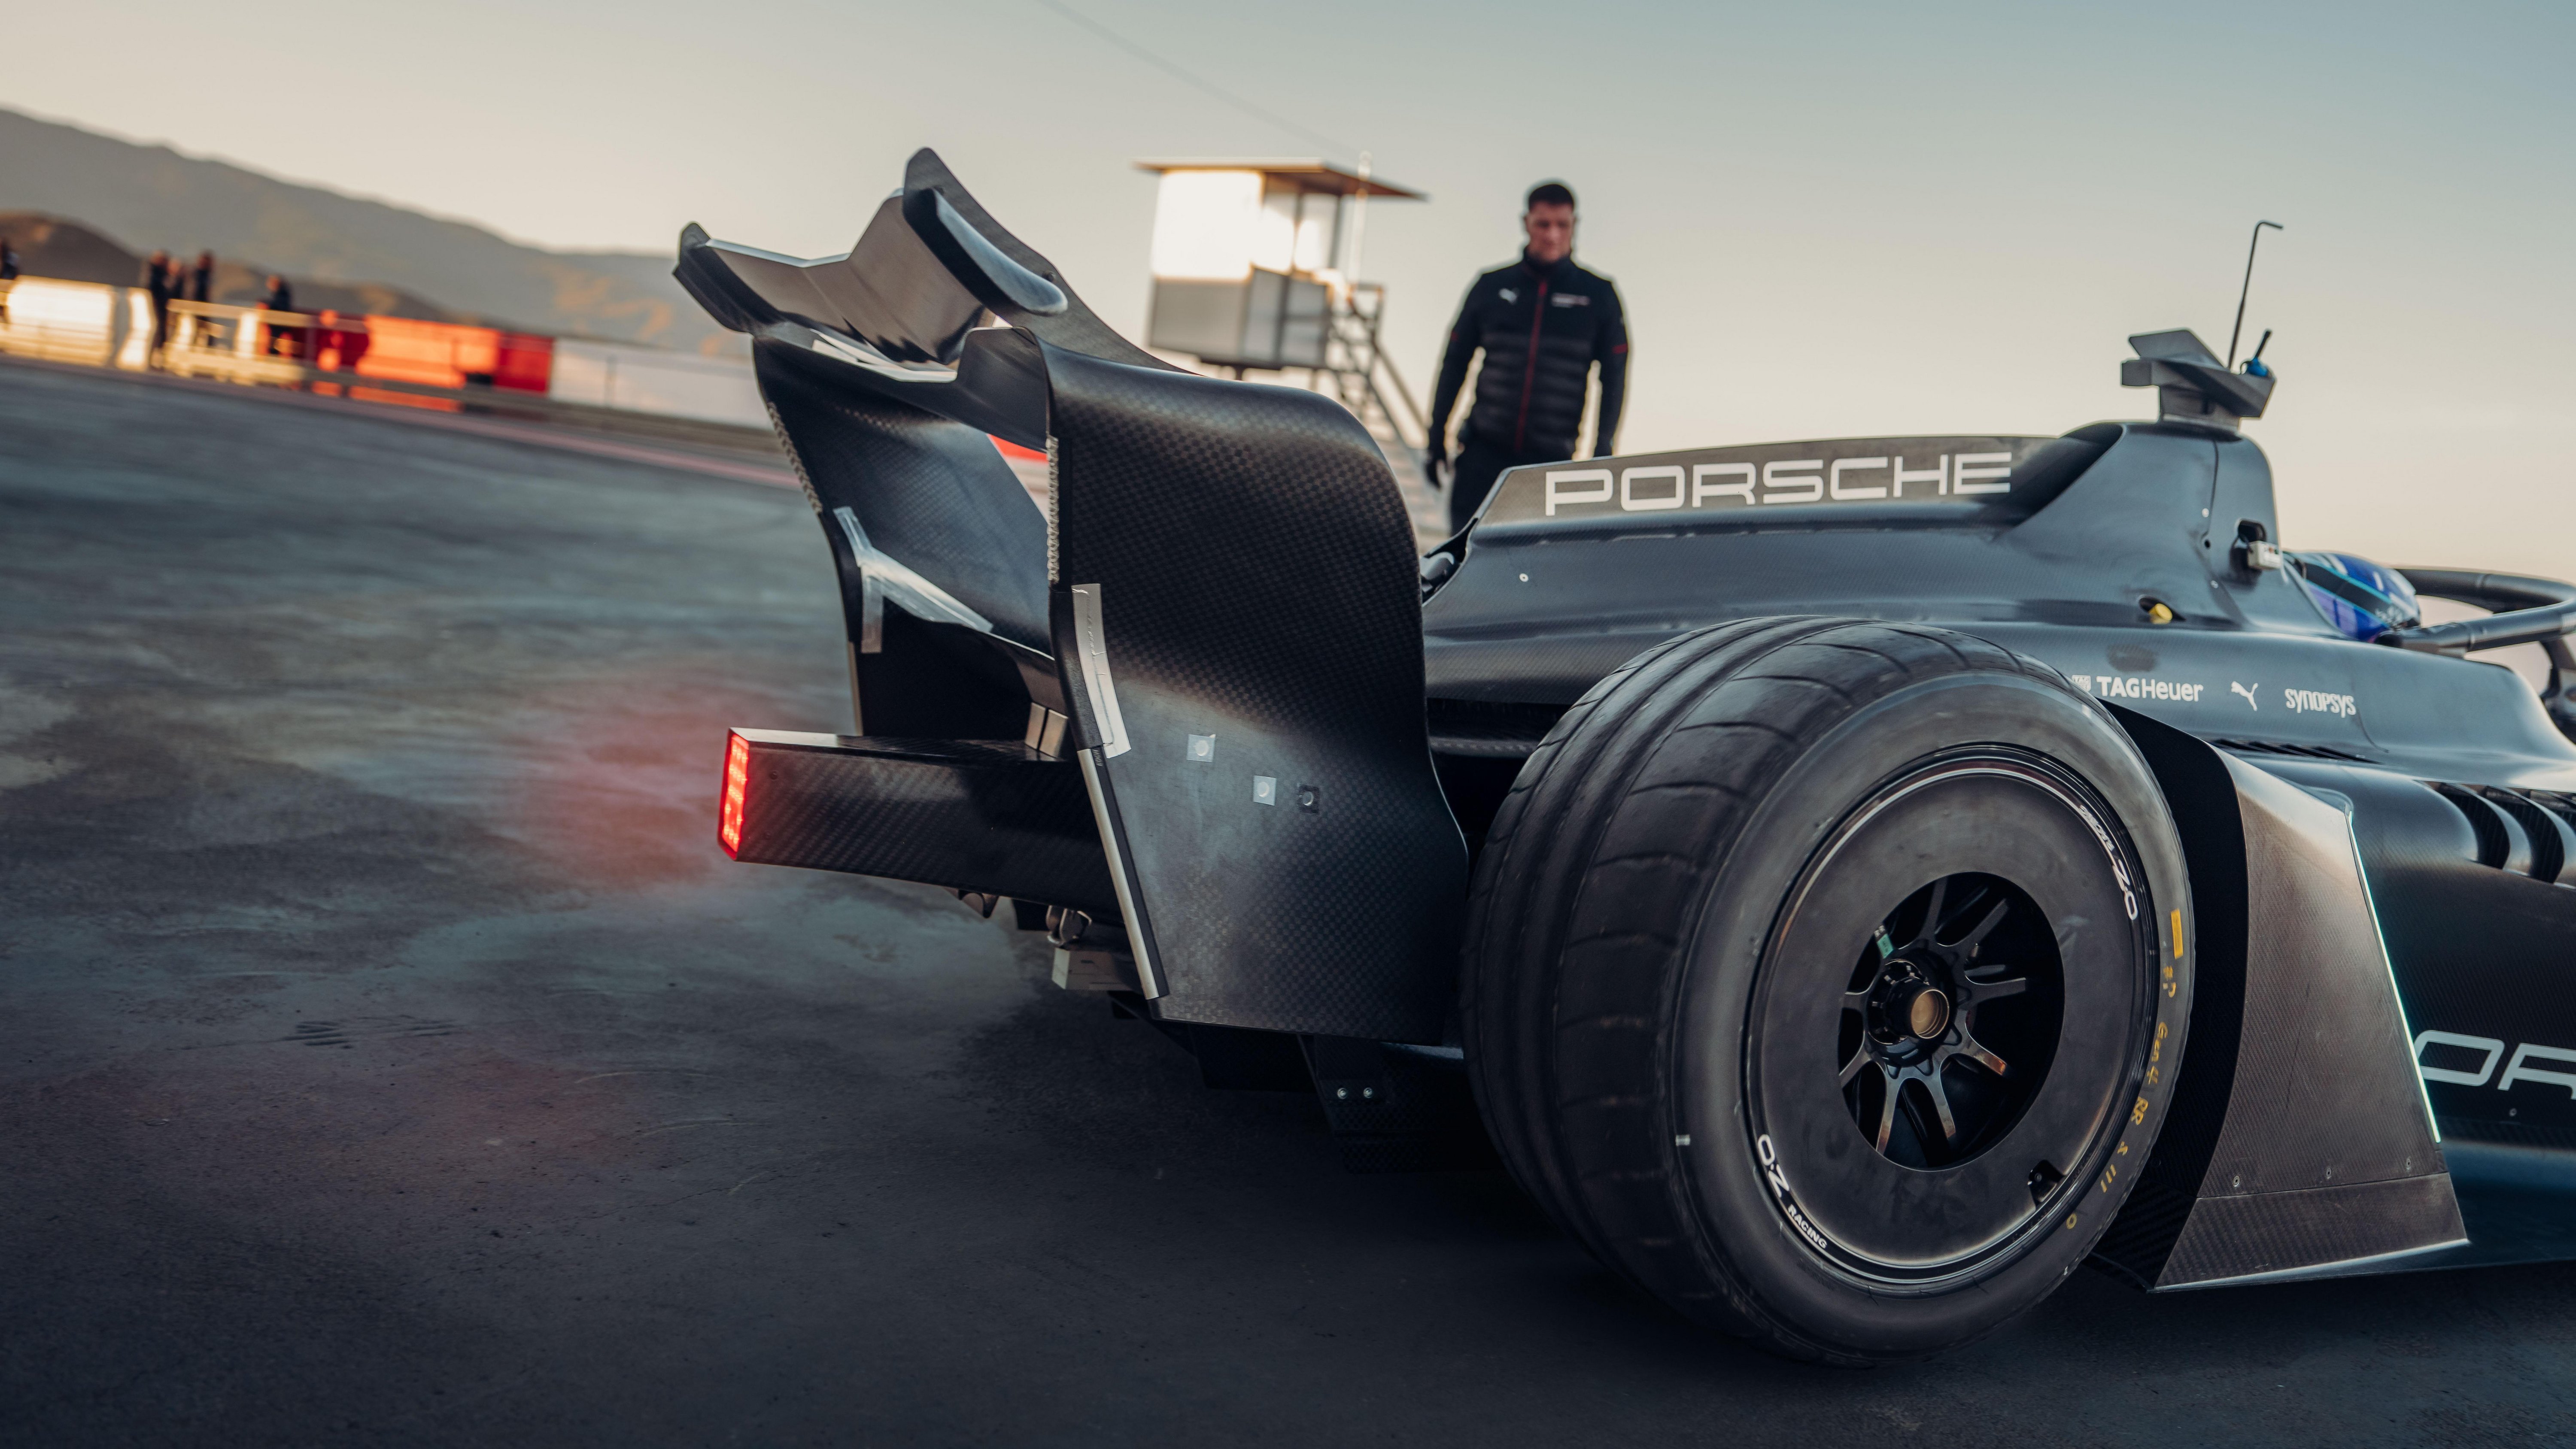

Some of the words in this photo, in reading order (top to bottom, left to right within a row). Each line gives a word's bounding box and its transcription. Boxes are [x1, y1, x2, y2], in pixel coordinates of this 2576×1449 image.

[1546, 452, 2012, 516] PORSCHE
[2284, 688, 2357, 718] SYNOPSYS
[1788, 1204, 1828, 1249] RACING
